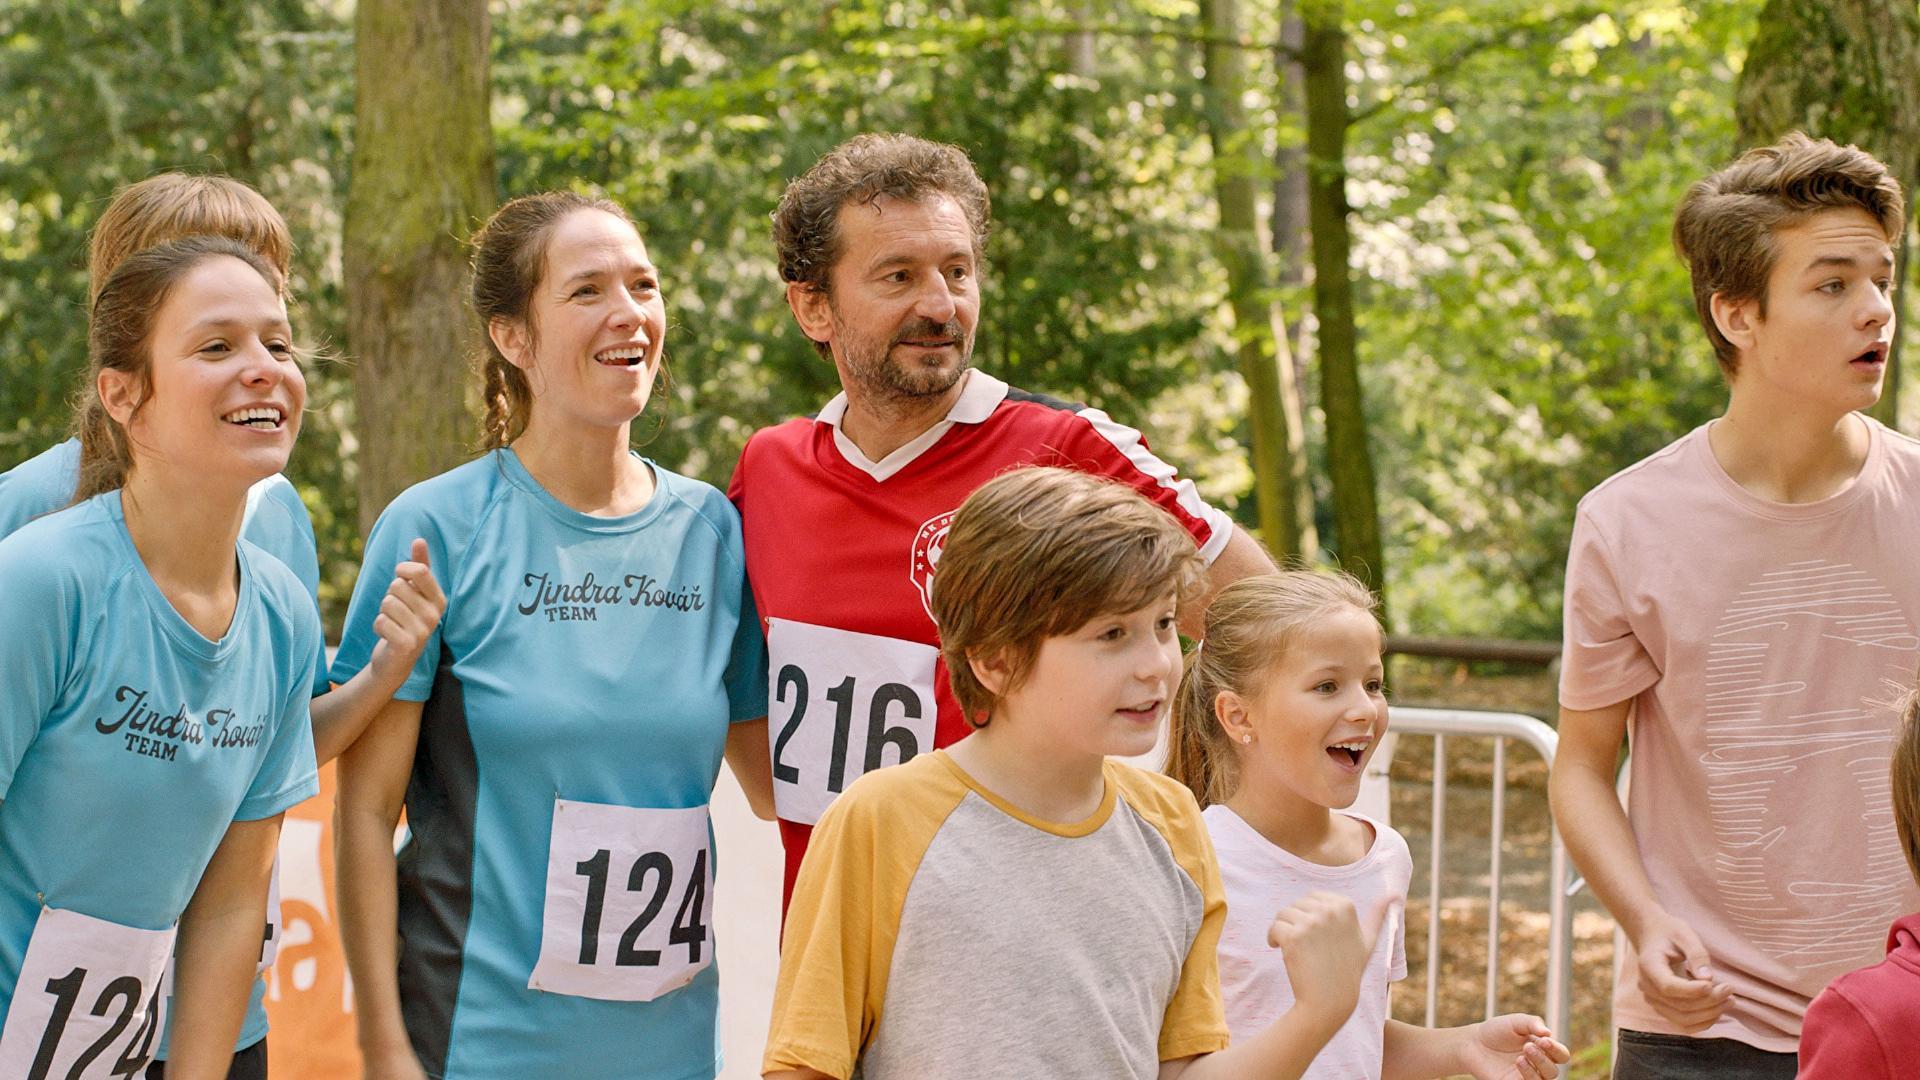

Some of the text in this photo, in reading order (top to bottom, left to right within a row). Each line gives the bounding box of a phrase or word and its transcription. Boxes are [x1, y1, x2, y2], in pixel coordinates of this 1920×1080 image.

[518, 572, 705, 615] Jindra Kovář
[545, 606, 597, 622] TEAM
[95, 685, 203, 745] Jindra
[773, 664, 922, 793] 216
[125, 732, 178, 761] TEAM
[575, 848, 706, 967] 124
[27, 967, 165, 1080] 124
